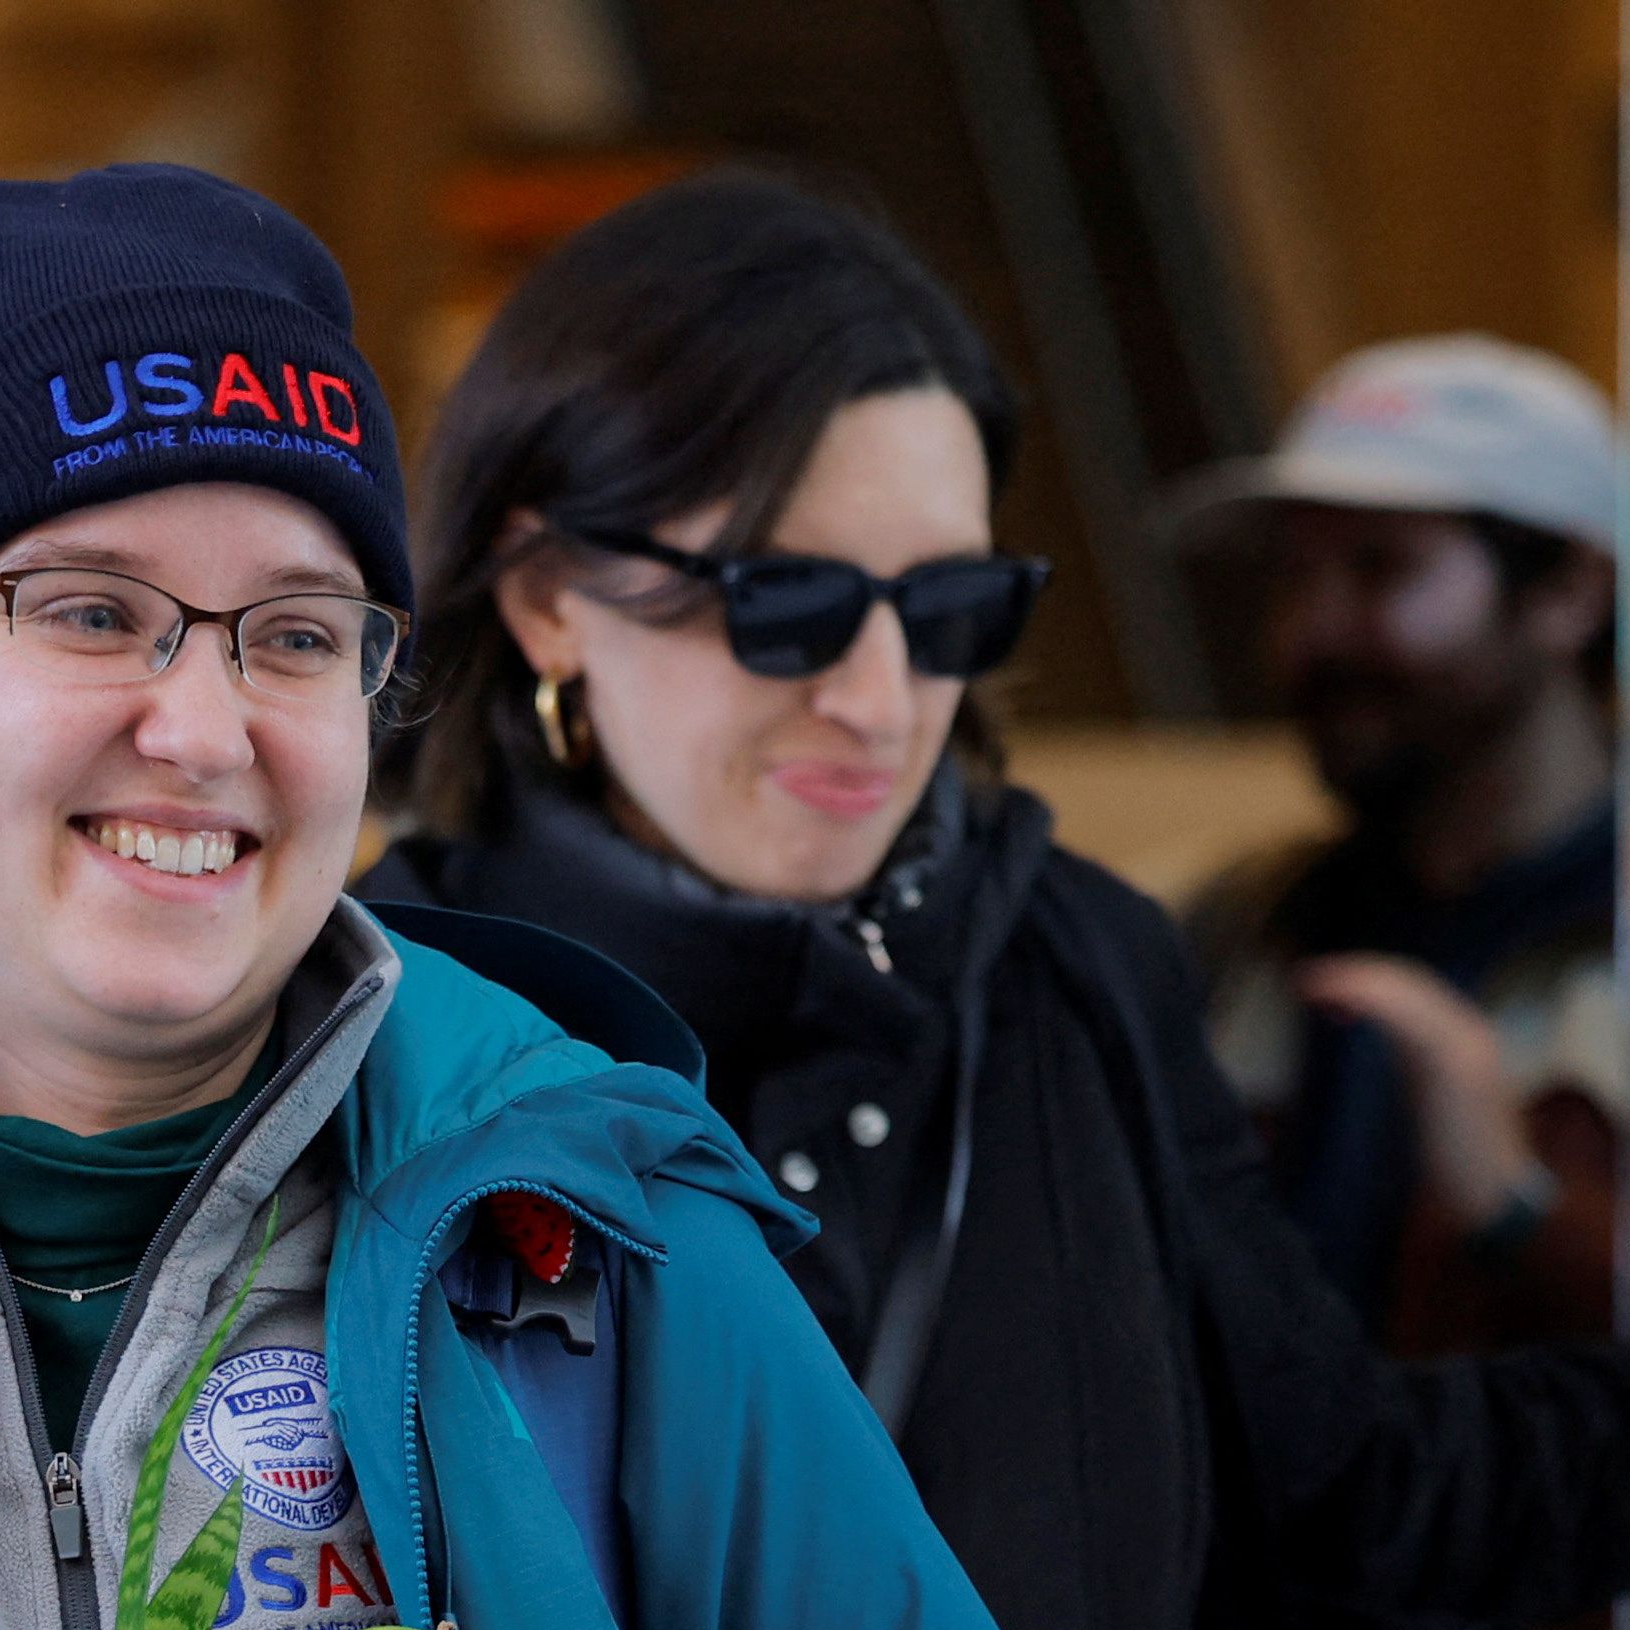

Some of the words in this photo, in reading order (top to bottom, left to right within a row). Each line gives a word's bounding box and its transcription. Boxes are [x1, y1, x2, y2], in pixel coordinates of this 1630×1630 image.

[49, 352, 361, 447] USAID
[53, 438, 127, 479] FROM
[133, 426, 180, 451] THE
[189, 424, 313, 455] AMERICAN
[185, 1377, 222, 1426] UNITED
[217, 1352, 283, 1382] STATES
[288, 1354, 329, 1380] AGE
[233, 1385, 306, 1413] USAID
